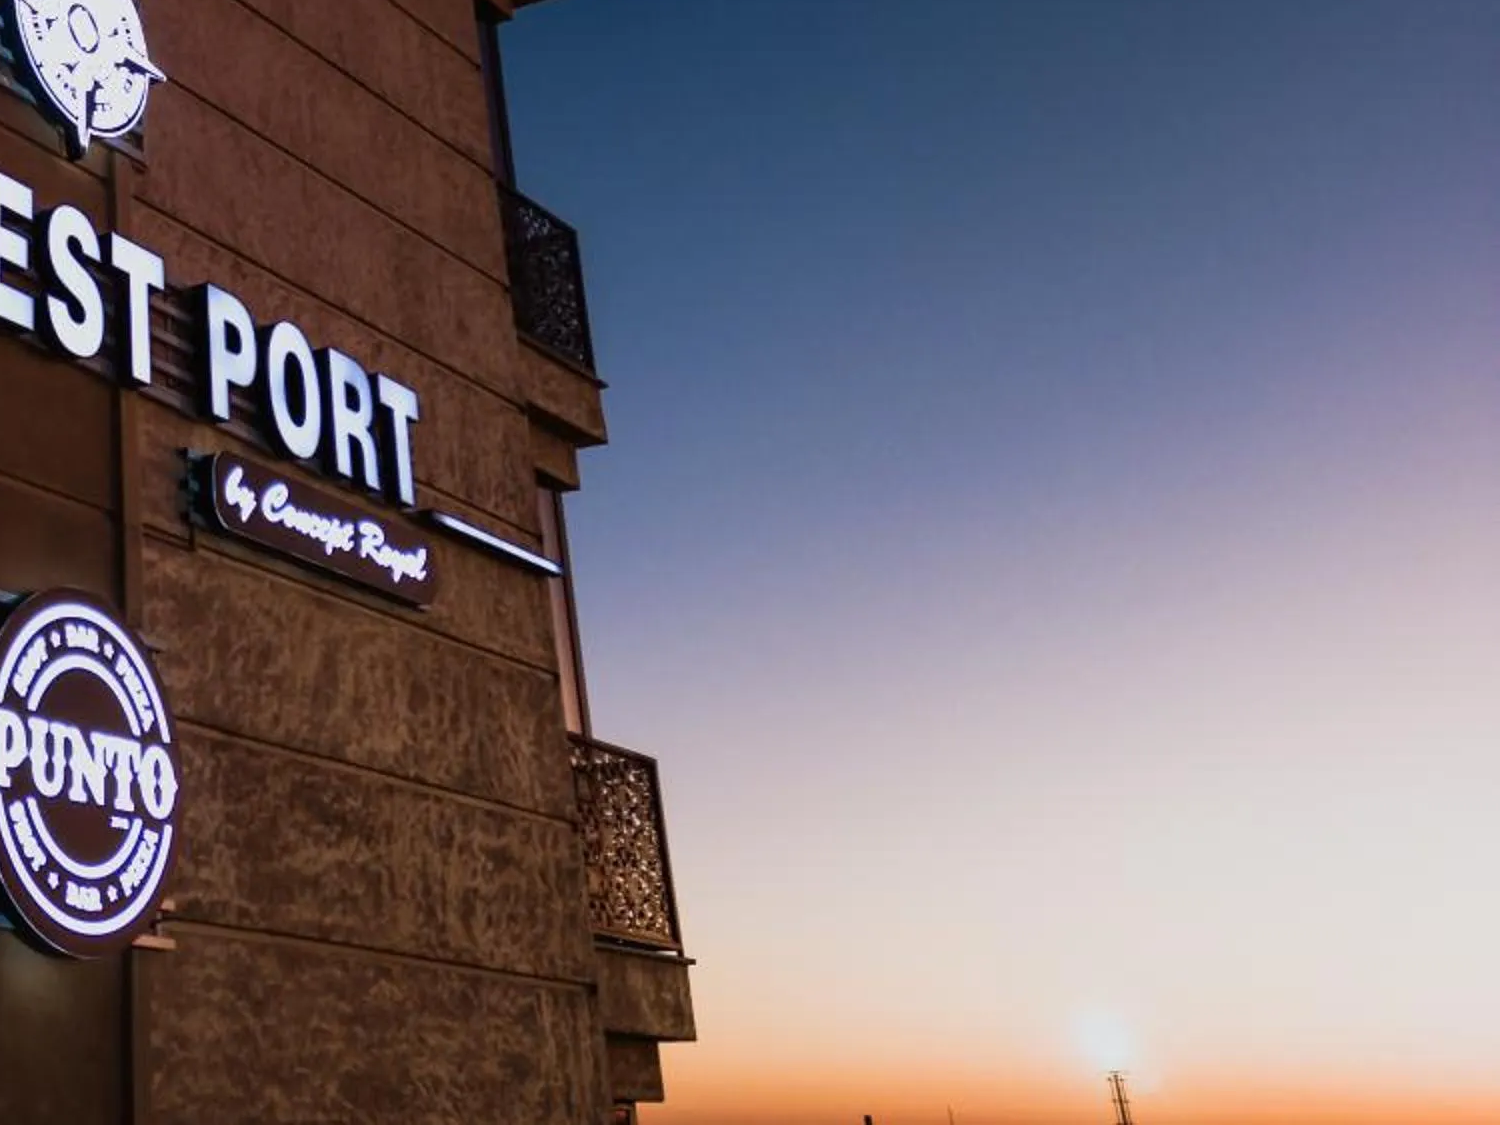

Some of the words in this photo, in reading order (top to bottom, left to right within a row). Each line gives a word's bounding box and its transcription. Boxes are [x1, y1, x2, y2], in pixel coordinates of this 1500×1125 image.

[208, 285, 418, 505] PORT
[224, 466, 257, 522] by
[261, 483, 355, 556] Concept
[358, 521, 427, 583] Royal
